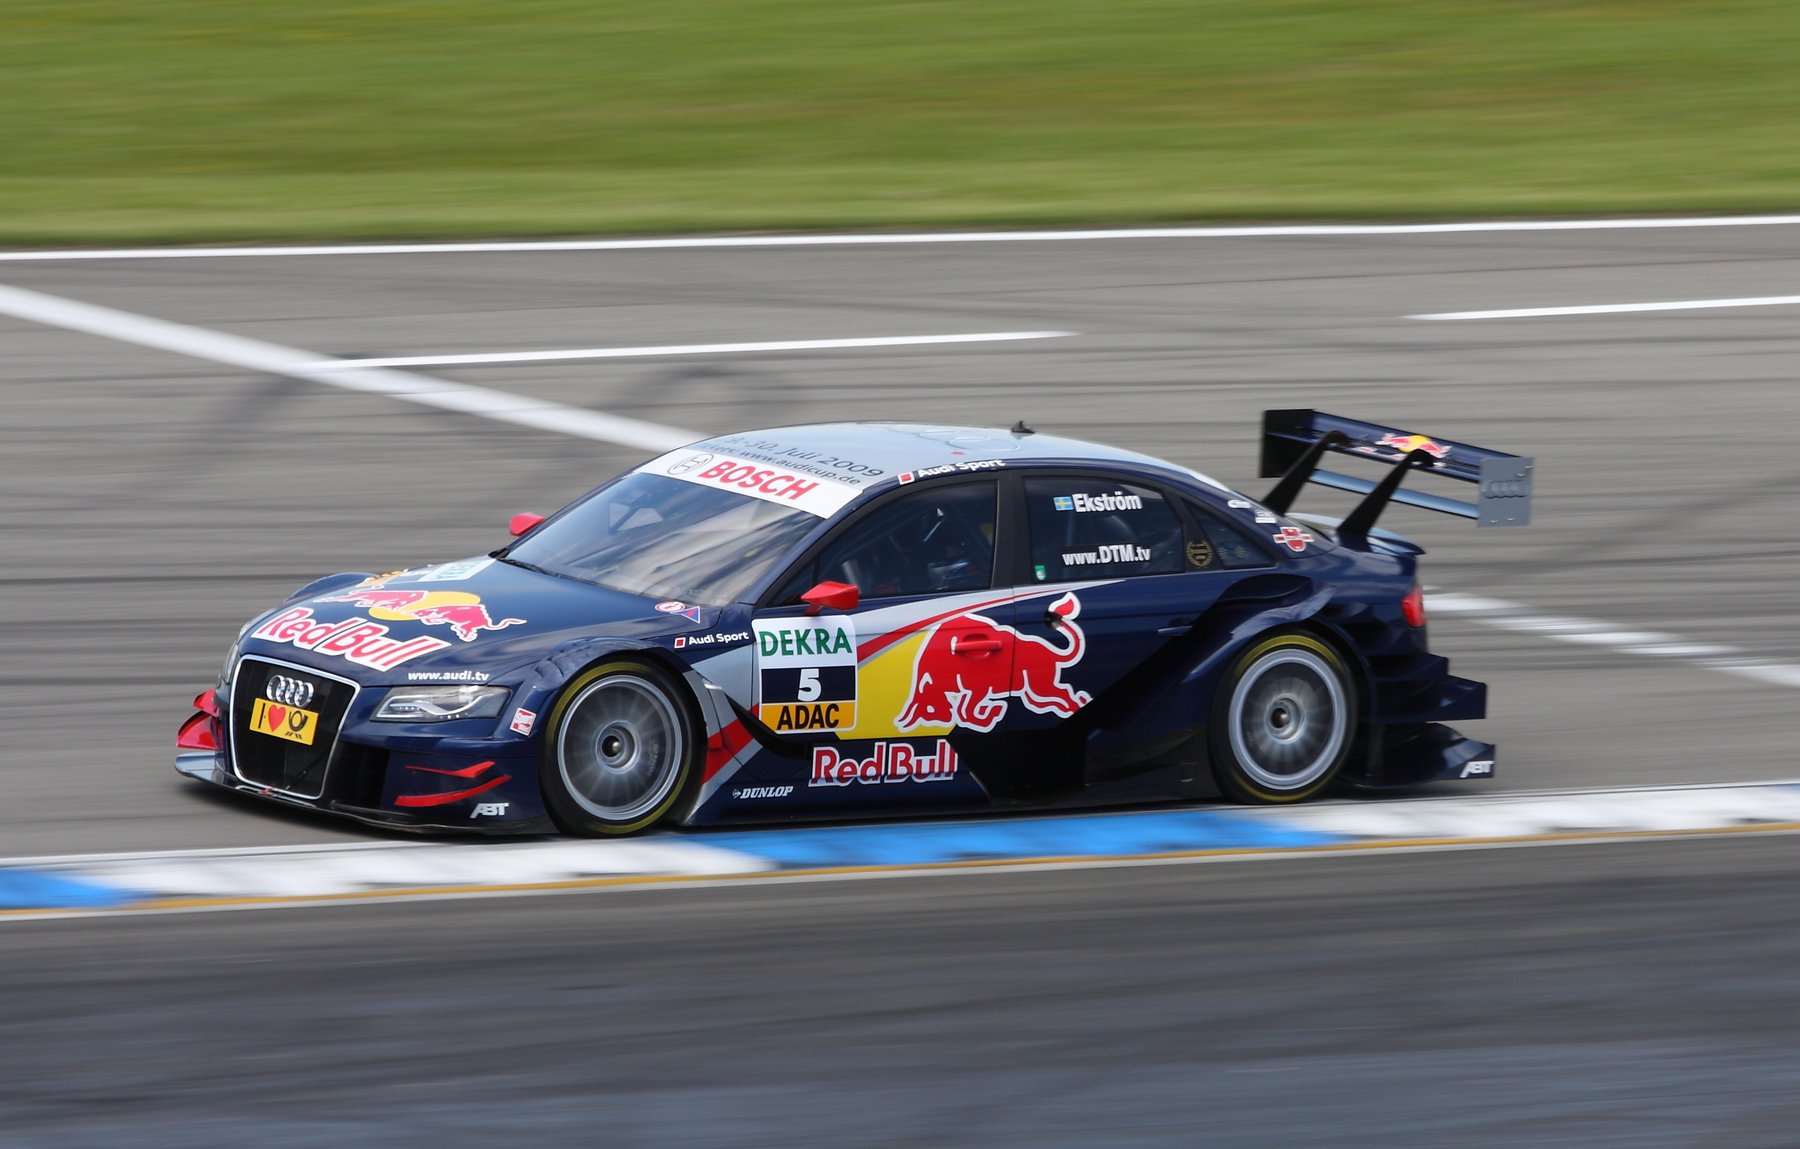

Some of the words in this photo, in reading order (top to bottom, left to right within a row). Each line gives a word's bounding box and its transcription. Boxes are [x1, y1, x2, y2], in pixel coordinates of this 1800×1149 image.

[739, 450, 861, 485] www.audicup.de
[774, 447, 821, 460] Juli
[818, 456, 885, 477] 2009
[917, 464, 956, 478] Audi
[956, 459, 1006, 471] Sport
[698, 460, 820, 501] BOSCH
[1072, 491, 1142, 512] Ekström
[1062, 544, 1151, 566] www.DTM.tv
[253, 607, 363, 648] Red
[316, 621, 449, 669] Bull
[689, 634, 715, 645] Audi
[716, 631, 750, 643] Sport
[758, 627, 852, 657] DEKRA
[408, 670, 490, 682] www.audi.tv
[797, 668, 822, 702] 5
[776, 703, 839, 731] ADAC
[809, 742, 886, 787] Red
[885, 739, 958, 784] Bull
[1459, 760, 1495, 779] ABT
[740, 785, 794, 799] DUNLOP
[469, 802, 509, 819] ABT
